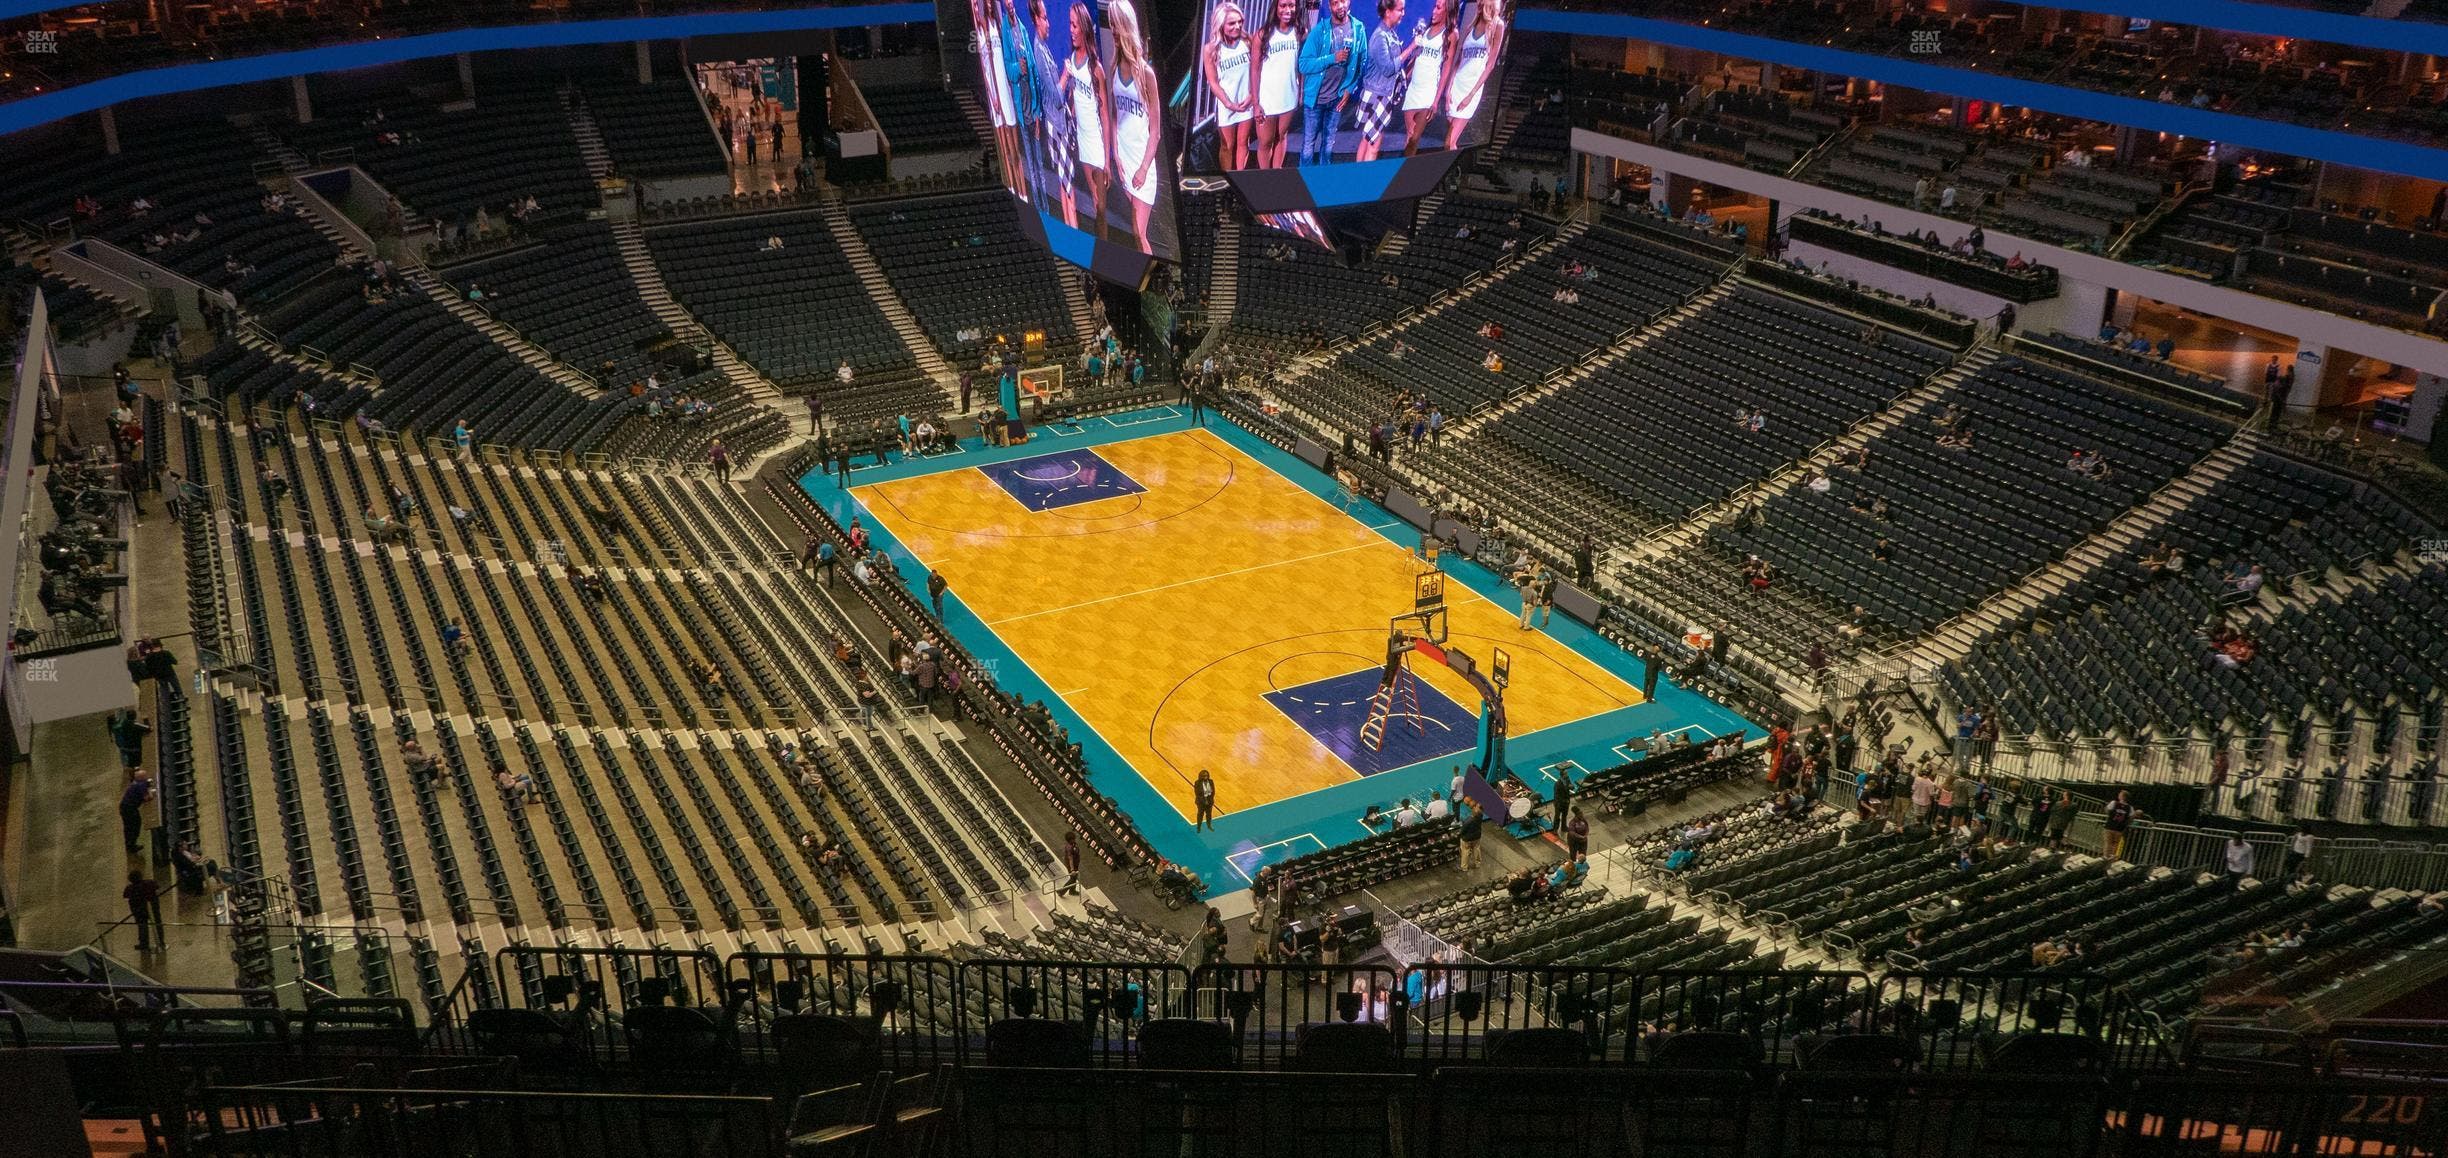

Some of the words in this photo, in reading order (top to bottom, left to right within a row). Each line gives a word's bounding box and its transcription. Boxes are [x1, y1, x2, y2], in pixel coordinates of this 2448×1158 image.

[1269, 40, 1299, 55] HORNE
[1219, 52, 1251, 72] HORNET
[1116, 95, 1144, 118] ORNETS
[2340, 1095, 2424, 1124] 220
